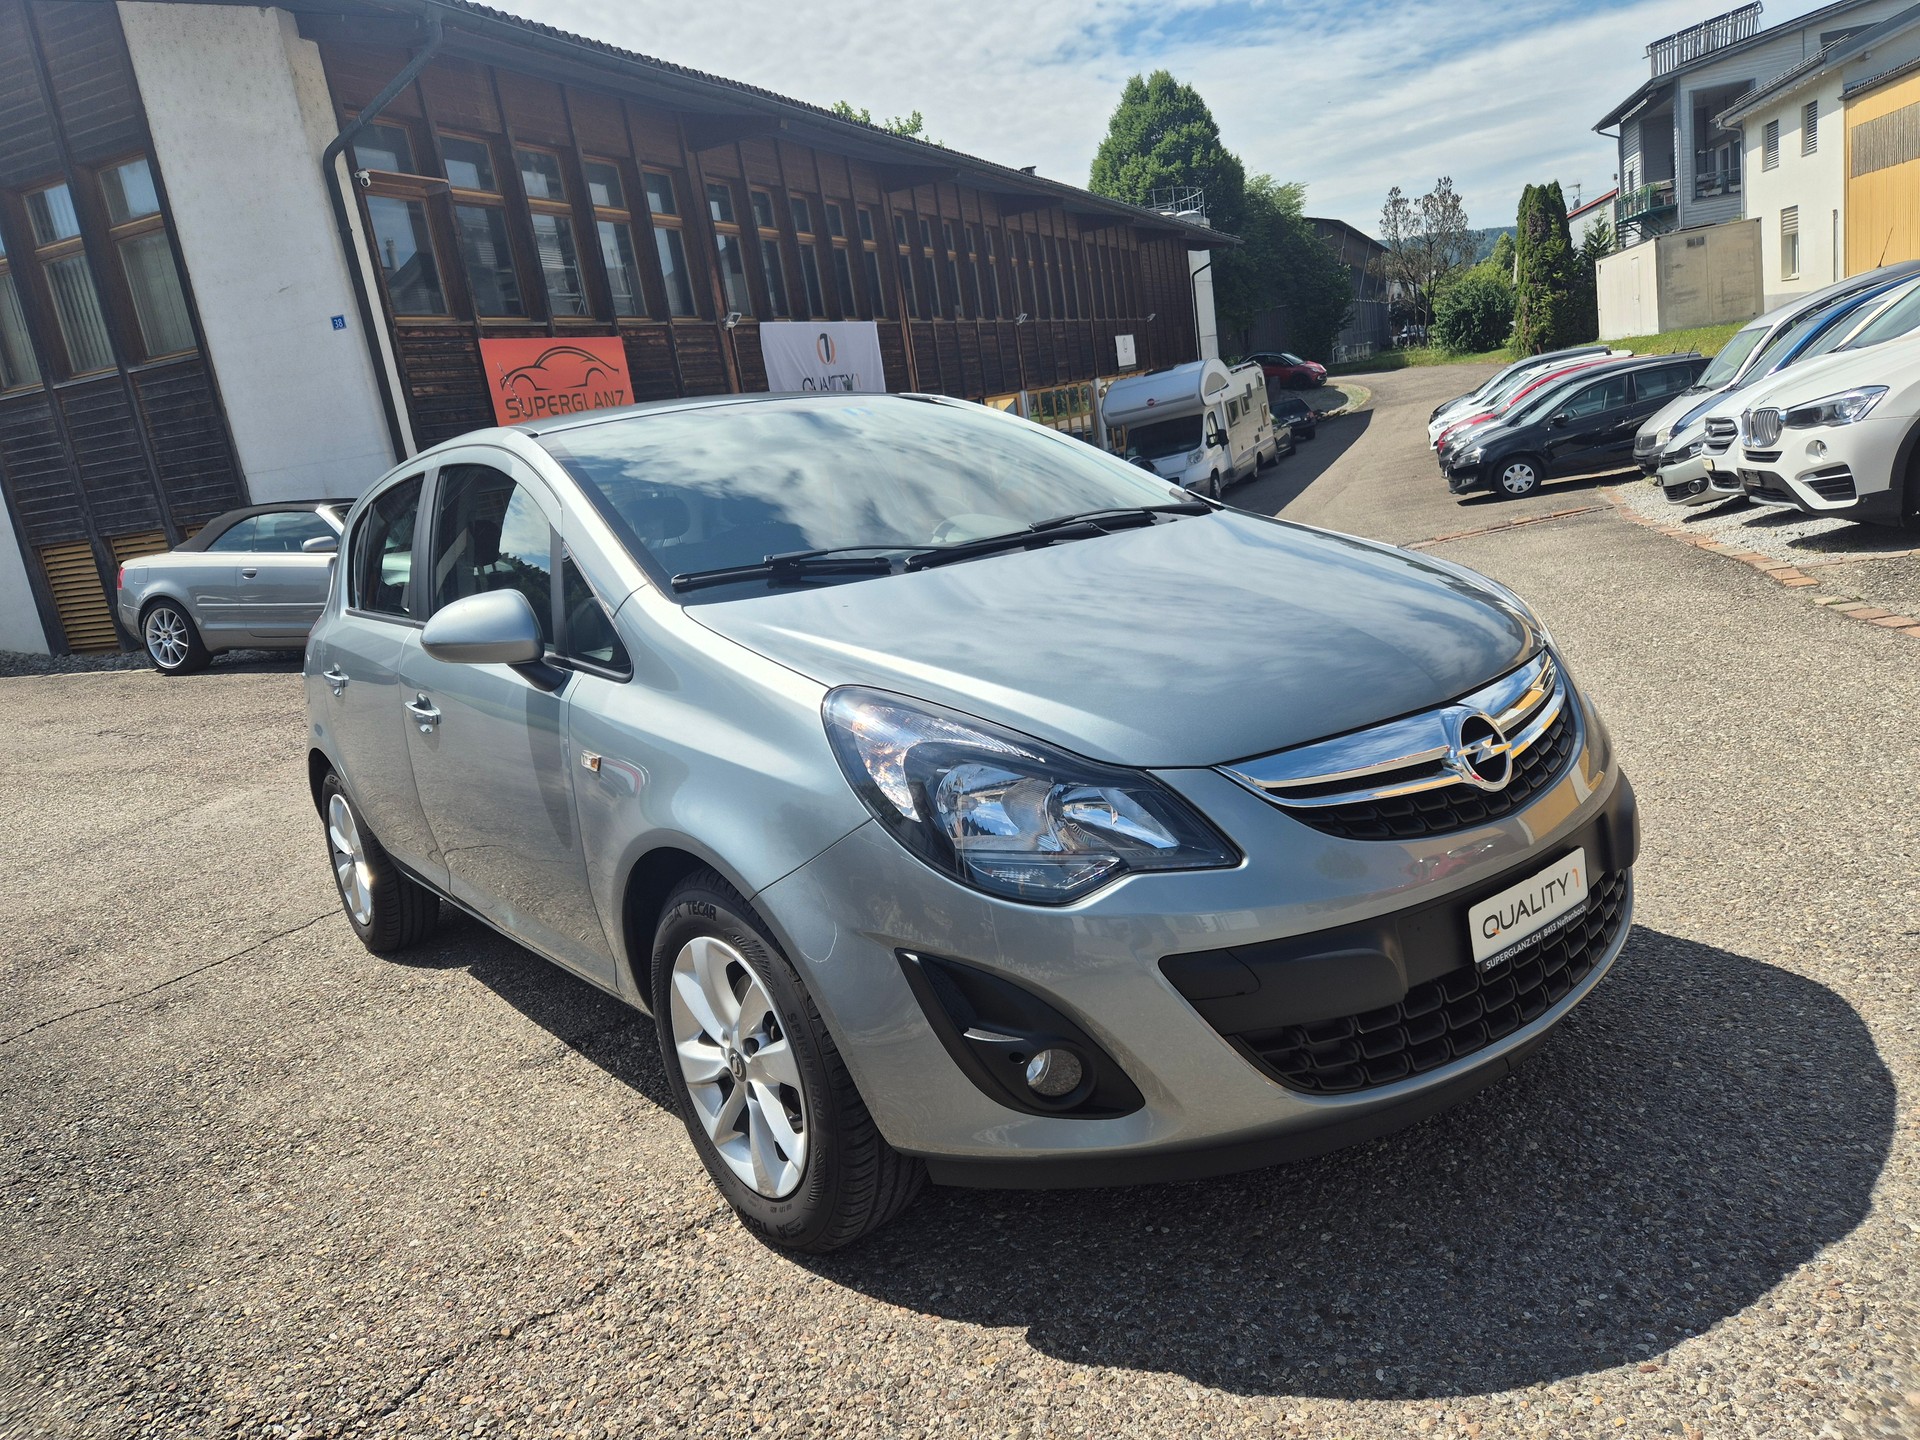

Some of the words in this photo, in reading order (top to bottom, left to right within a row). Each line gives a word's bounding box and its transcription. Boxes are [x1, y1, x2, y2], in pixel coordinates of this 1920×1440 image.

[333, 318, 345, 329] 38
[505, 390, 624, 419] SUPERGLANZ
[685, 901, 717, 921] TECAR
[1482, 872, 1569, 939] QUALITY
[1572, 867, 1580, 888] 1
[1485, 932, 1541, 970] SUPERGLANZ.CH
[1543, 922, 1557, 937] 8413
